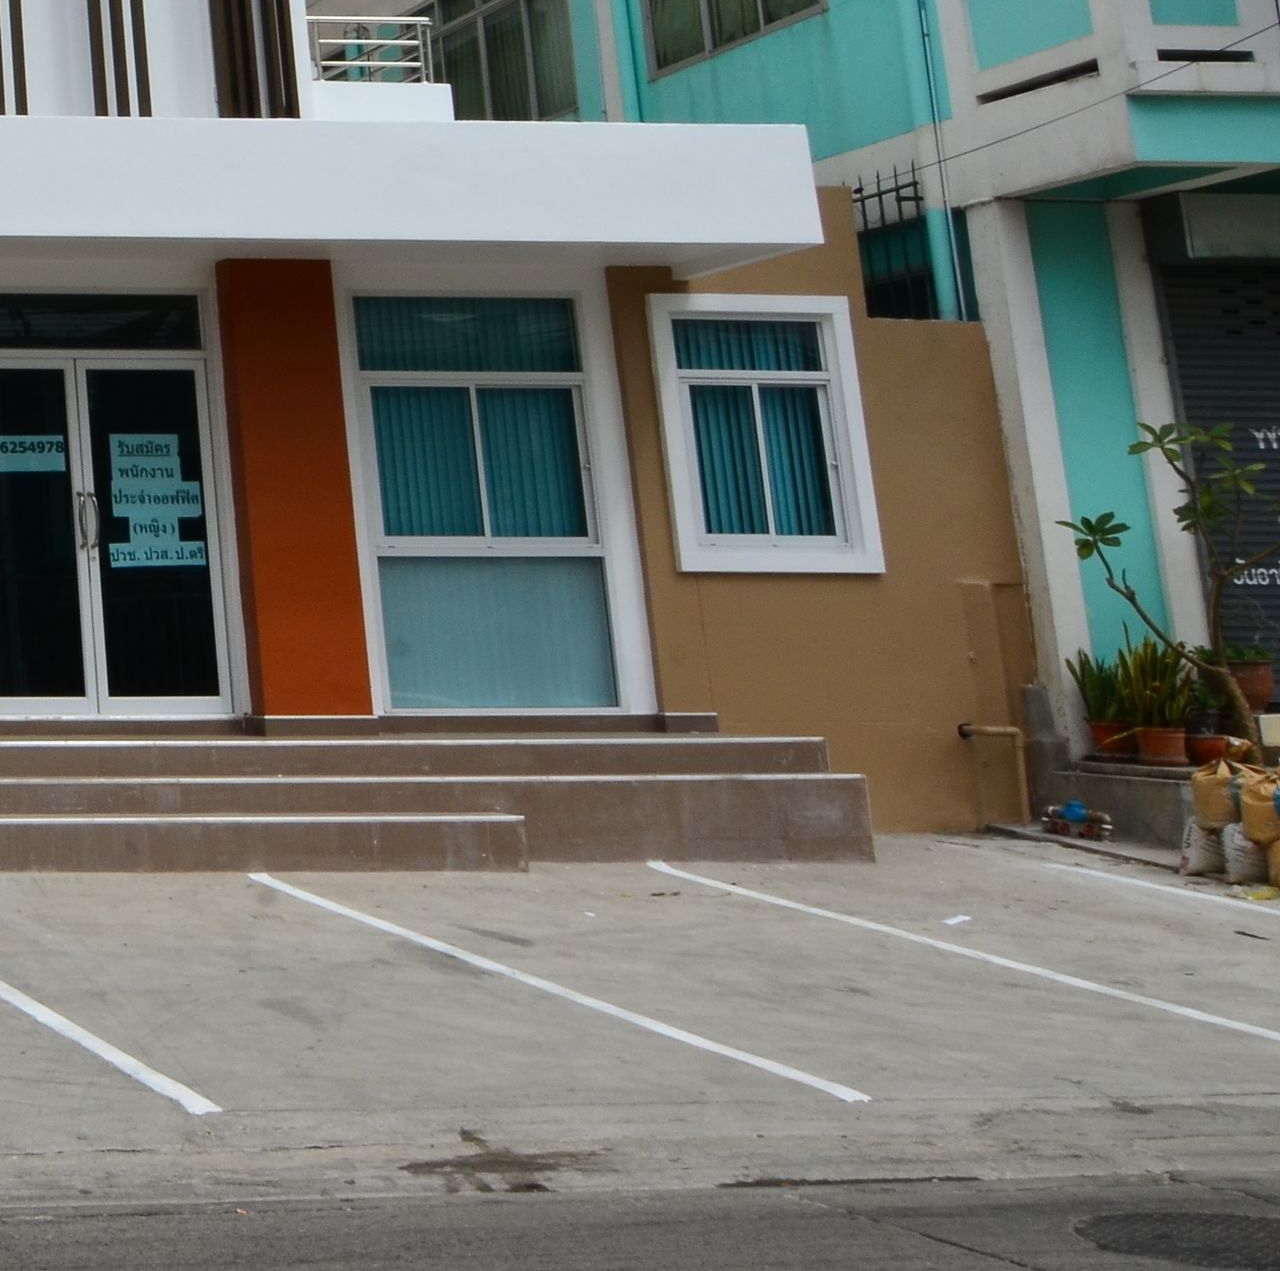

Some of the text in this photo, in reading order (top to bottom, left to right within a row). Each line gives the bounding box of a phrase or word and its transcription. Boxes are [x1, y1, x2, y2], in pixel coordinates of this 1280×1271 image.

[118, 439, 171, 457] รับสมัคร
[118, 464, 174, 479] พนักงาน
